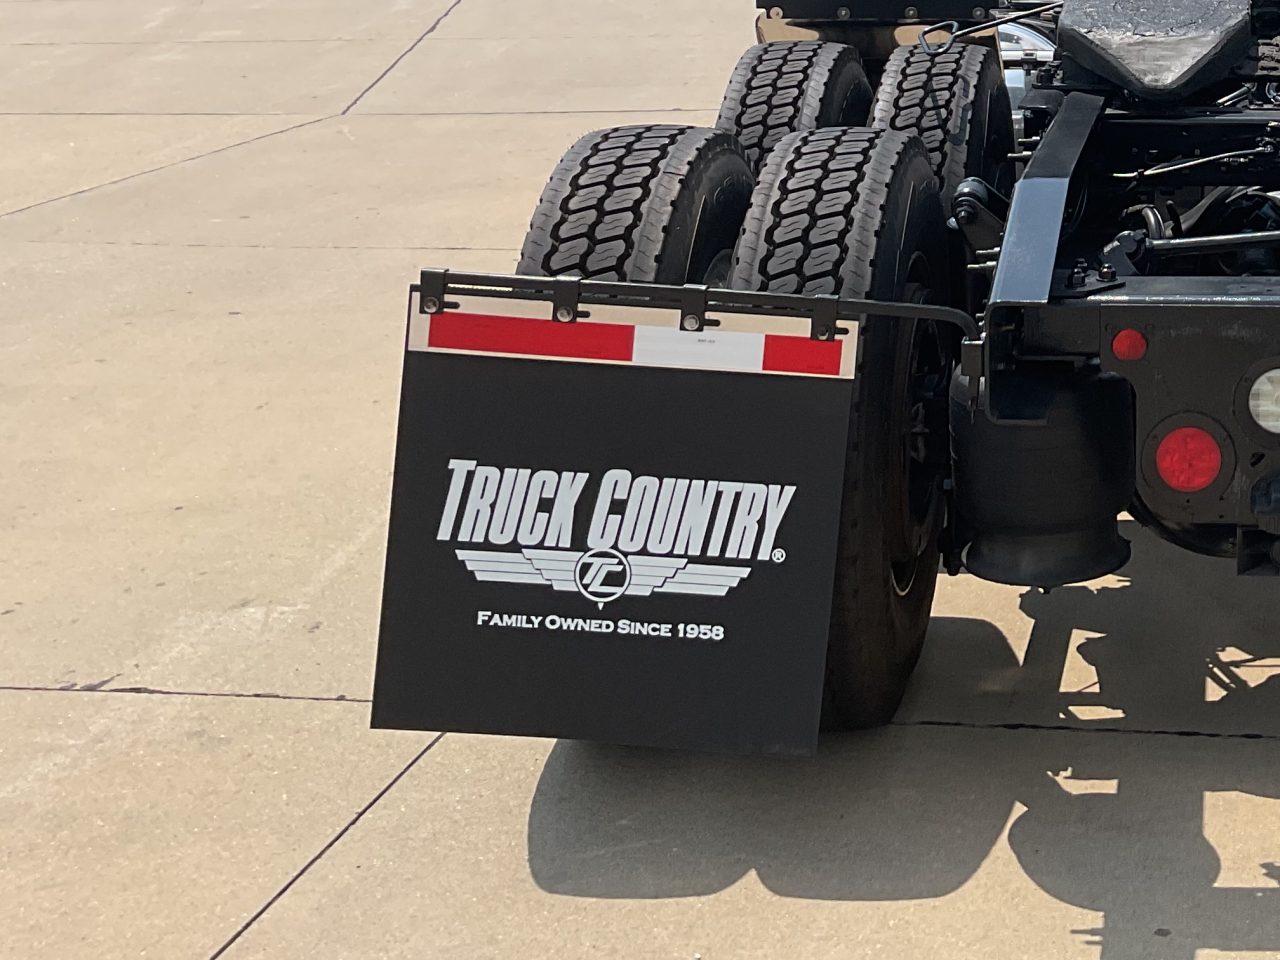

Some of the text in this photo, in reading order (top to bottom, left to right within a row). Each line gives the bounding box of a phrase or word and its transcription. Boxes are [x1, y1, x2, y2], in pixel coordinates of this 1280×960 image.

[436, 458, 589, 548] TRUCK
[477, 610, 725, 640] FAMILY OWNED SINCE 1958
